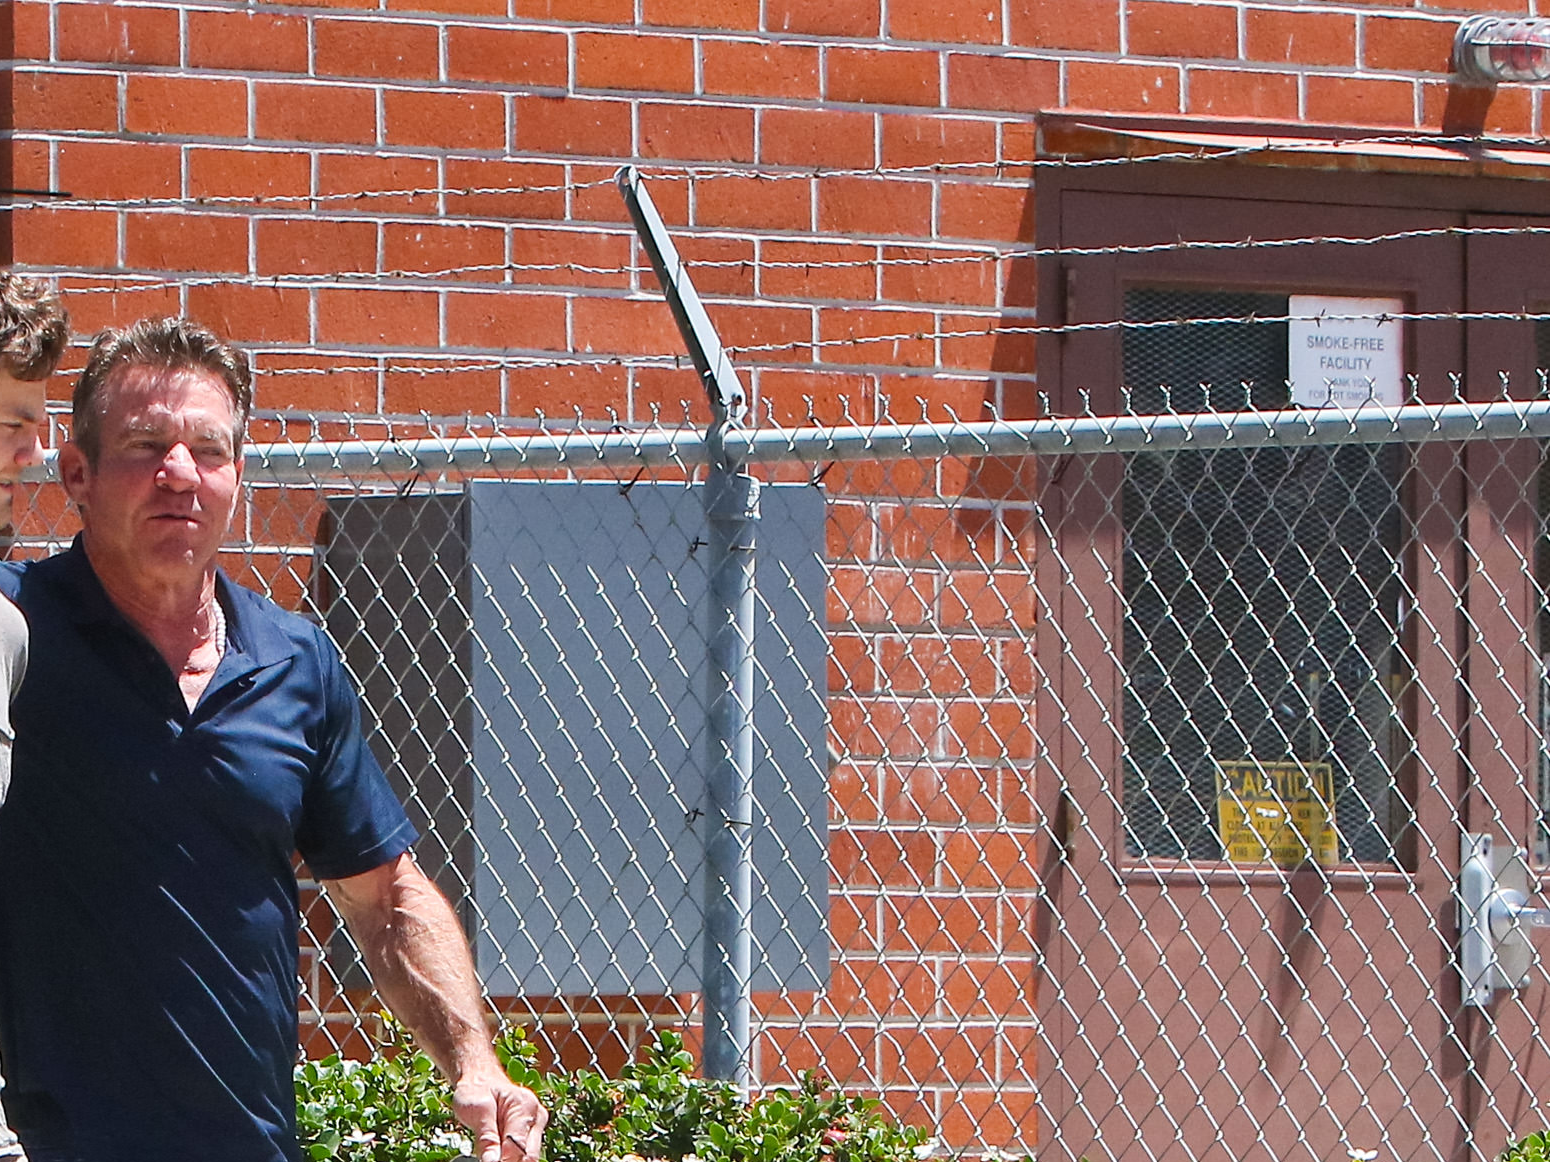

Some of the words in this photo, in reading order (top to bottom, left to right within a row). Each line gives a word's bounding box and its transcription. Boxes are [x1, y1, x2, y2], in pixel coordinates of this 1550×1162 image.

[1306, 335, 1384, 351] SMOKE-FREE
[1320, 356, 1372, 370] FACILITY
[1328, 390, 1343, 400] OT
